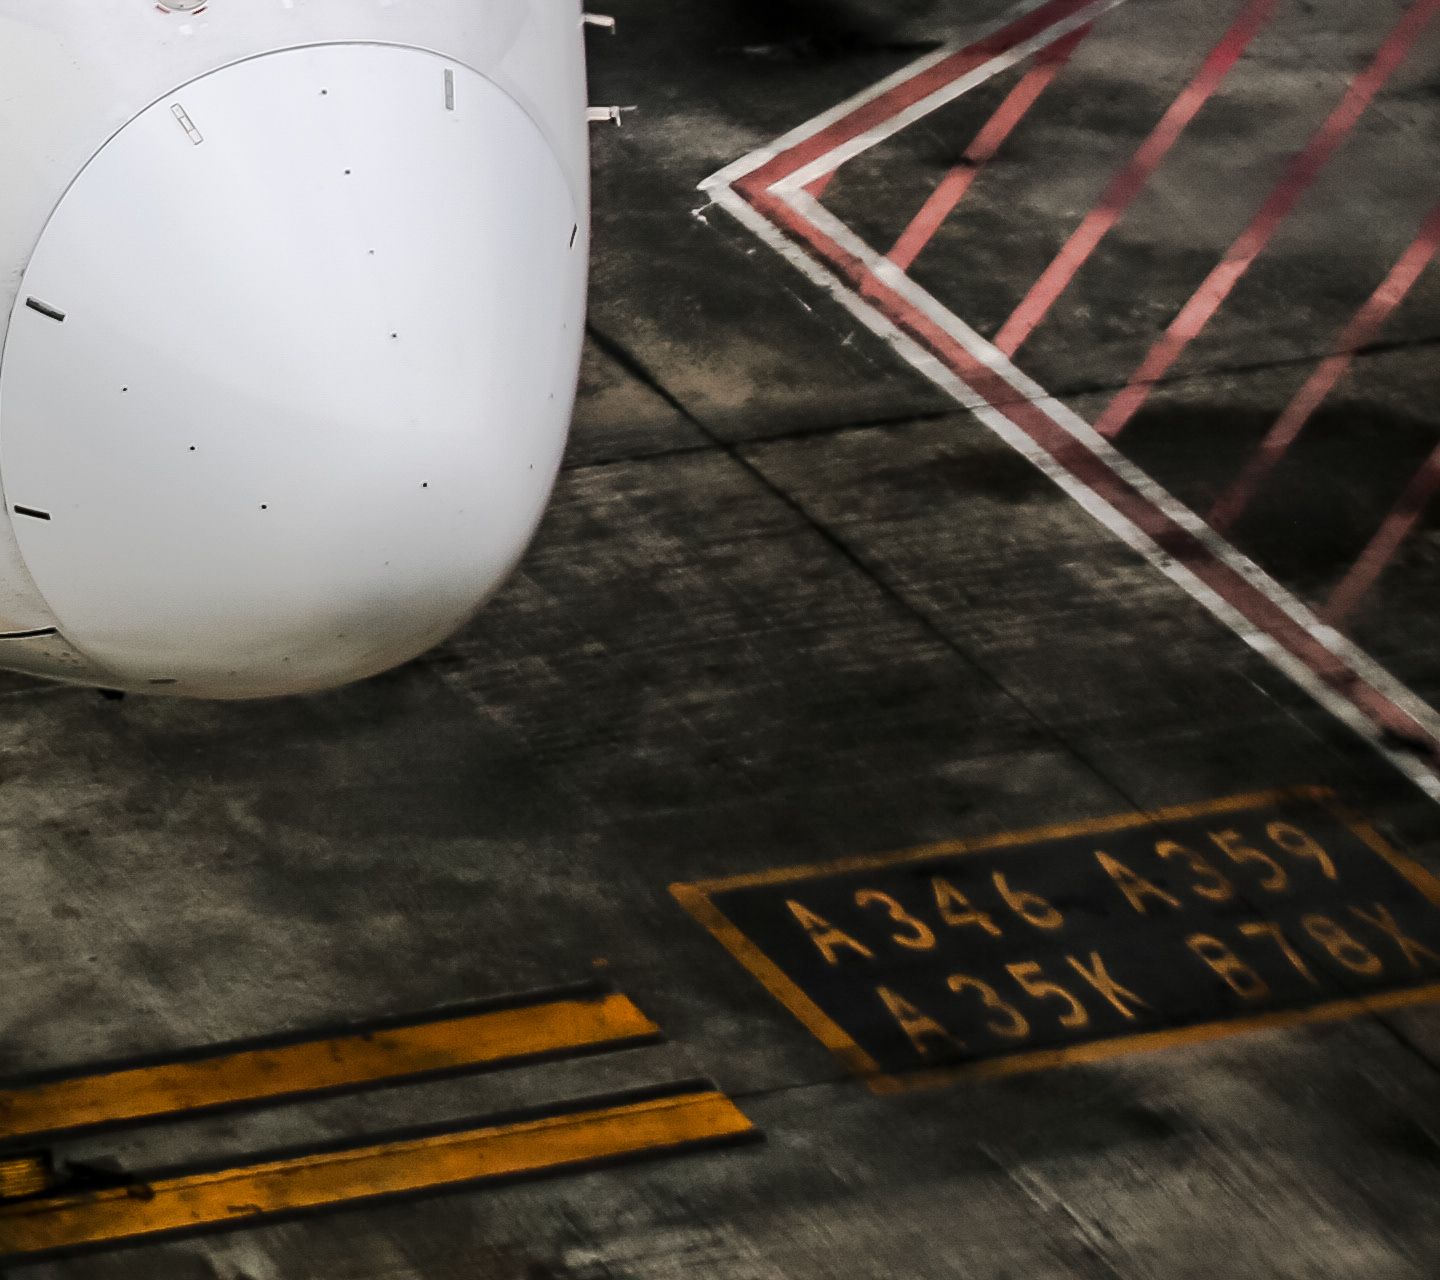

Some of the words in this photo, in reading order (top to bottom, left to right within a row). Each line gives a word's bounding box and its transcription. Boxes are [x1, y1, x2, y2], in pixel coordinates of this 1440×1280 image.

[785, 870, 1064, 966] A346
[1094, 821, 1338, 915] A359
[876, 951, 1151, 1056] A35K
